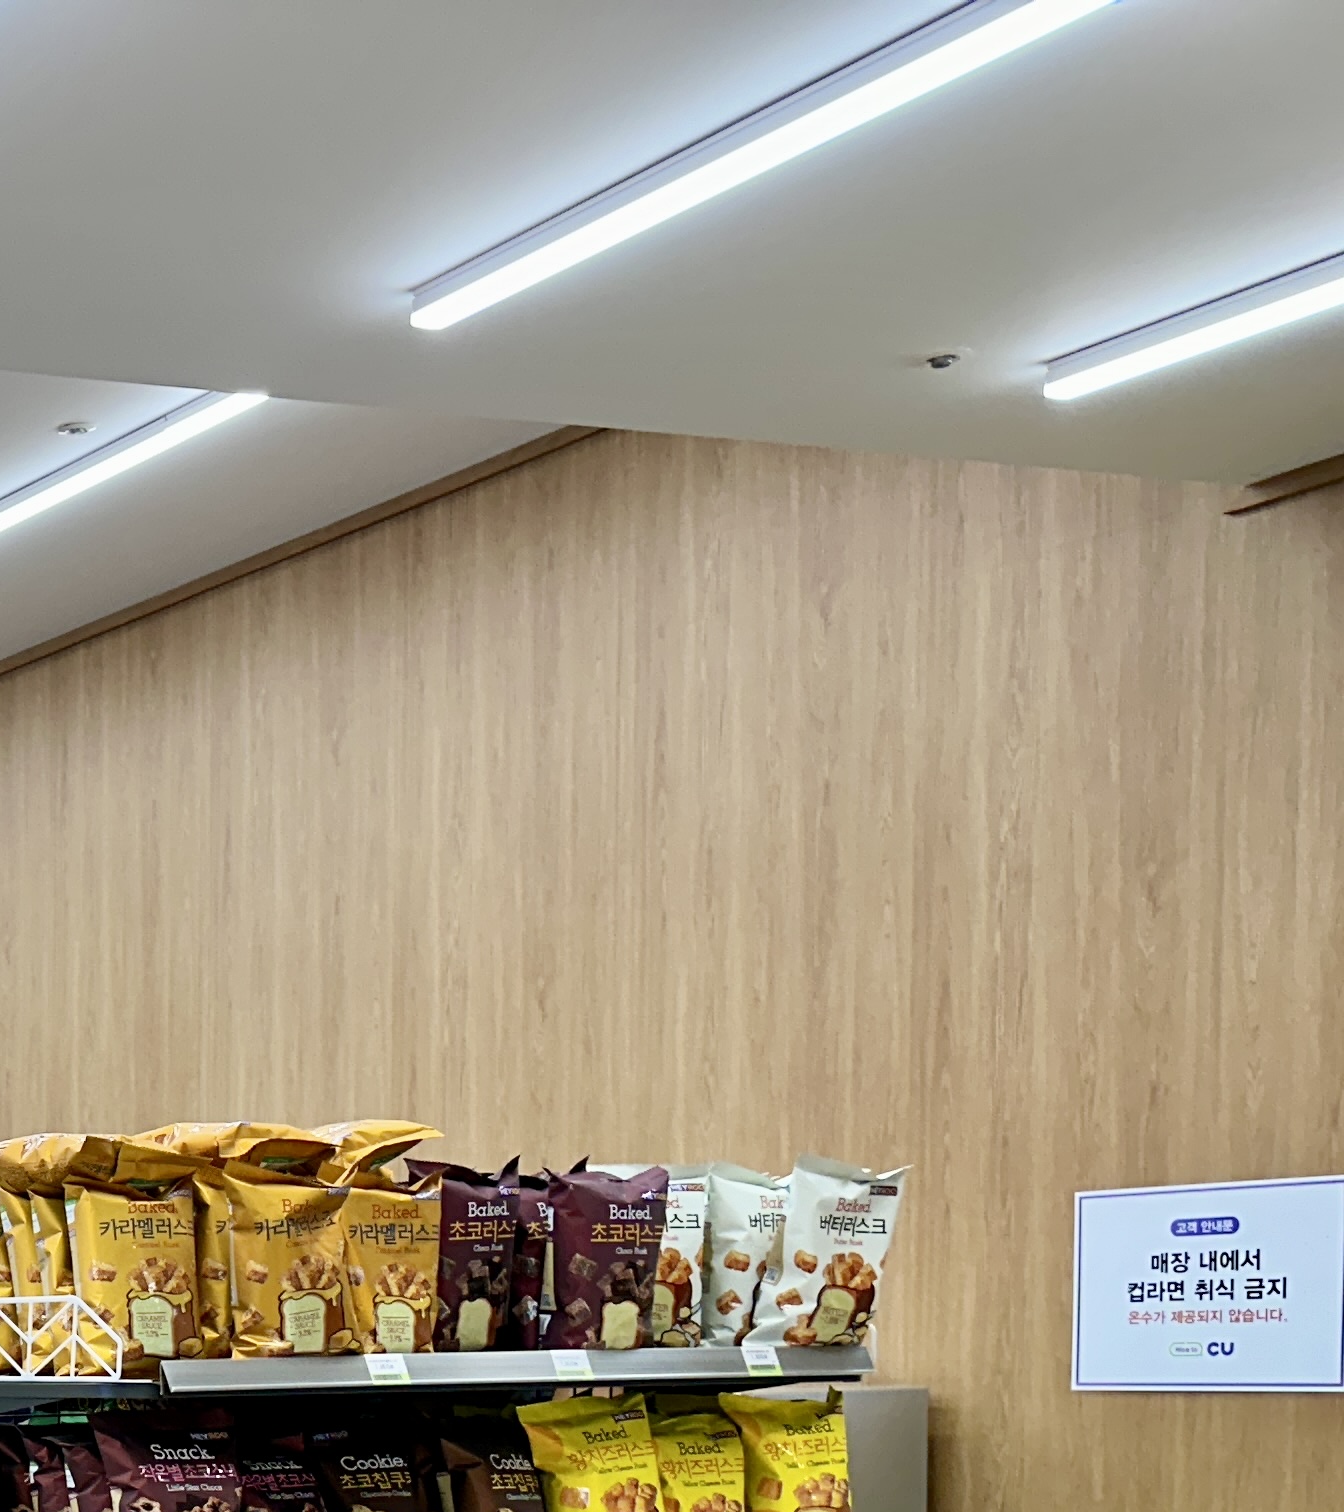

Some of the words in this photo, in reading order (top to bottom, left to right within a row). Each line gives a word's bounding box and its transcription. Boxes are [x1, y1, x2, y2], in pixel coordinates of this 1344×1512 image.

[820, 1215, 887, 1237] 버터러스크
[1151, 1251, 1190, 1273] 매장
[1199, 1249, 1261, 1271] 내에서
[1128, 1281, 1185, 1302] 컵라면
[1195, 1279, 1235, 1300] 취식
[1244, 1277, 1287, 1300] 금지
[1128, 1310, 1165, 1325] 온수가
[1171, 1309, 1223, 1323] 제공되지
[1229, 1308, 1287, 1323] 않습니다.
[1207, 1342, 1234, 1356] CU
